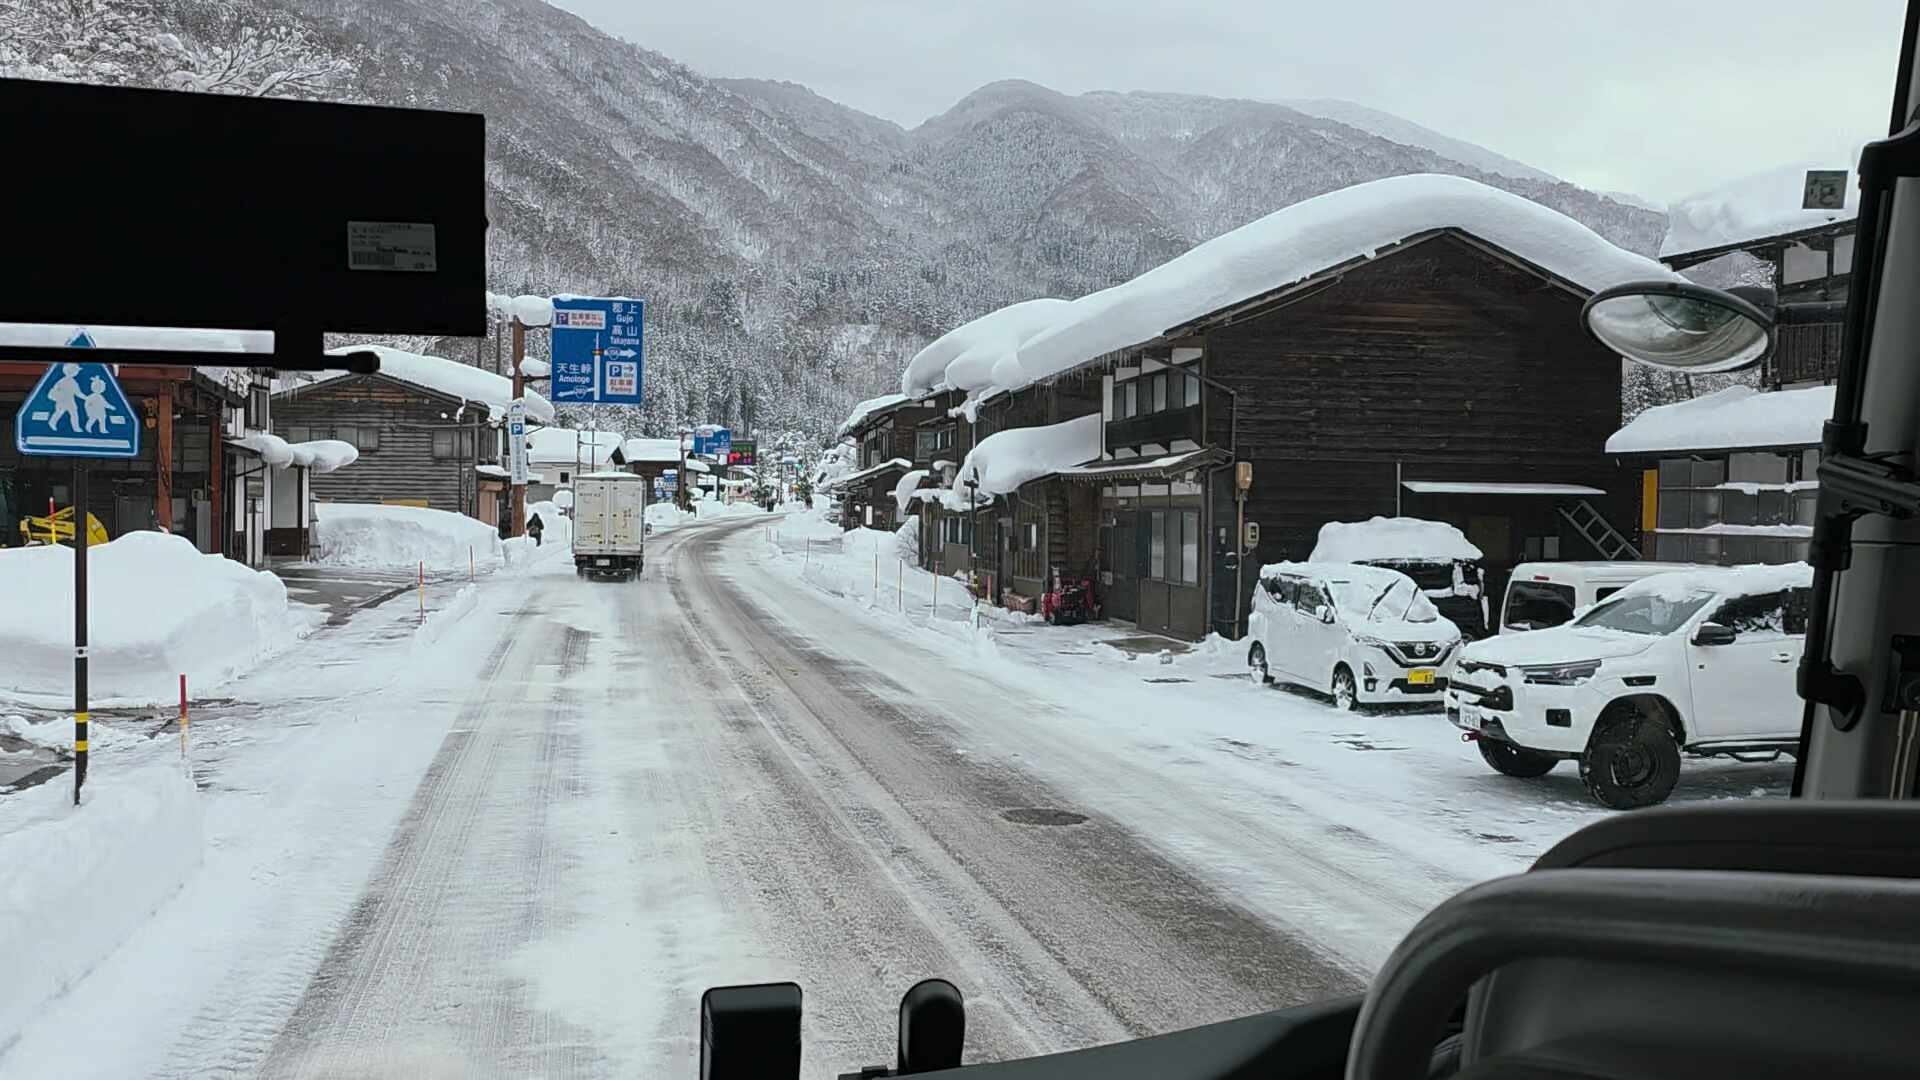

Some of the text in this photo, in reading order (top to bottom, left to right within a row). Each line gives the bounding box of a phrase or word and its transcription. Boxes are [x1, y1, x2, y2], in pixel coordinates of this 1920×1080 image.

[616, 314, 634, 323] Gujo
[611, 325, 638, 337] 高山
[611, 336, 639, 346] Takayama
[557, 363, 592, 374] 天生峠
